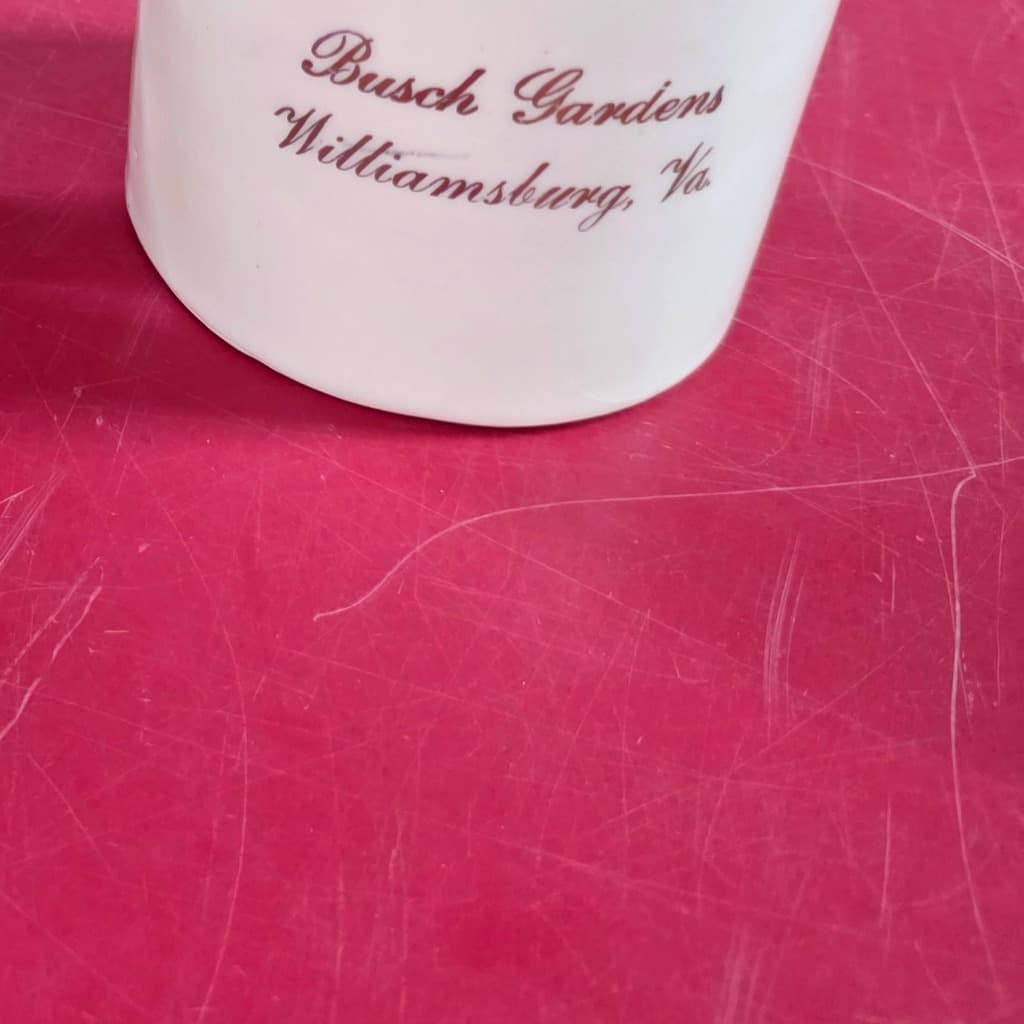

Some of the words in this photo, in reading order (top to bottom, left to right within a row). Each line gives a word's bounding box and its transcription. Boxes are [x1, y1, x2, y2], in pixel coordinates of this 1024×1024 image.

[300, 29, 487, 116] Busch
[511, 67, 724, 126] Gardens
[273, 106, 634, 233] Williamsburg,
